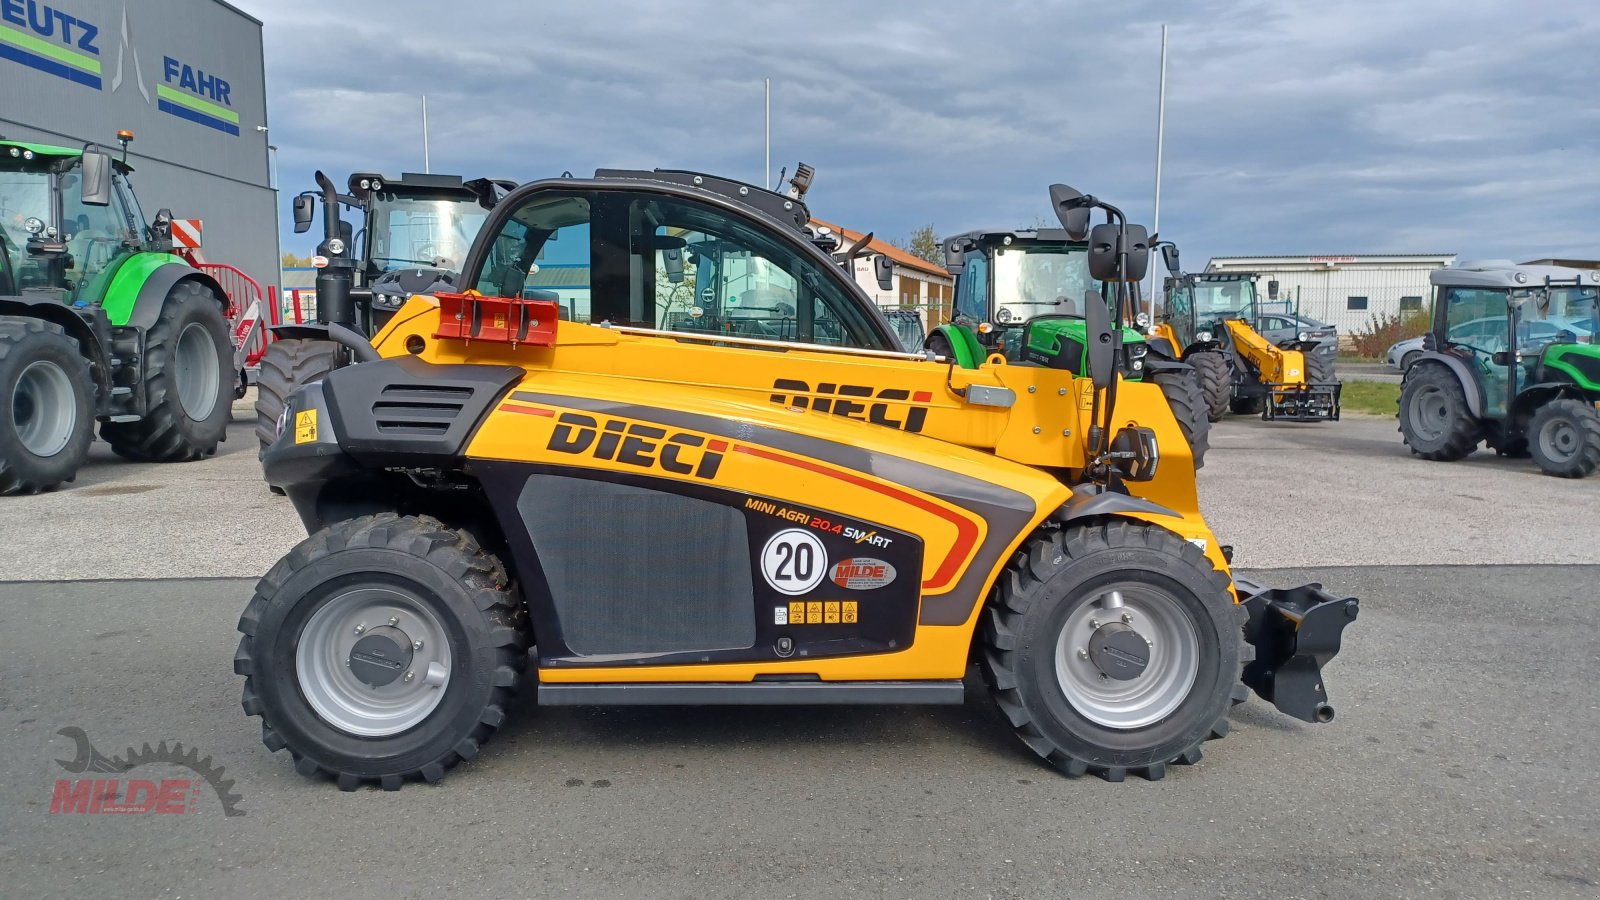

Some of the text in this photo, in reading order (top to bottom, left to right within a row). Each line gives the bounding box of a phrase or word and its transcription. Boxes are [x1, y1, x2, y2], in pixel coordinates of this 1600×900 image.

[164, 55, 231, 105] FAHR
[770, 378, 932, 433] DIECI
[546, 412, 727, 479] DIECI
[745, 498, 893, 549] MINI AGRI 20.4 SMART
[775, 542, 814, 582] 20
[836, 566, 885, 578] MILDE
